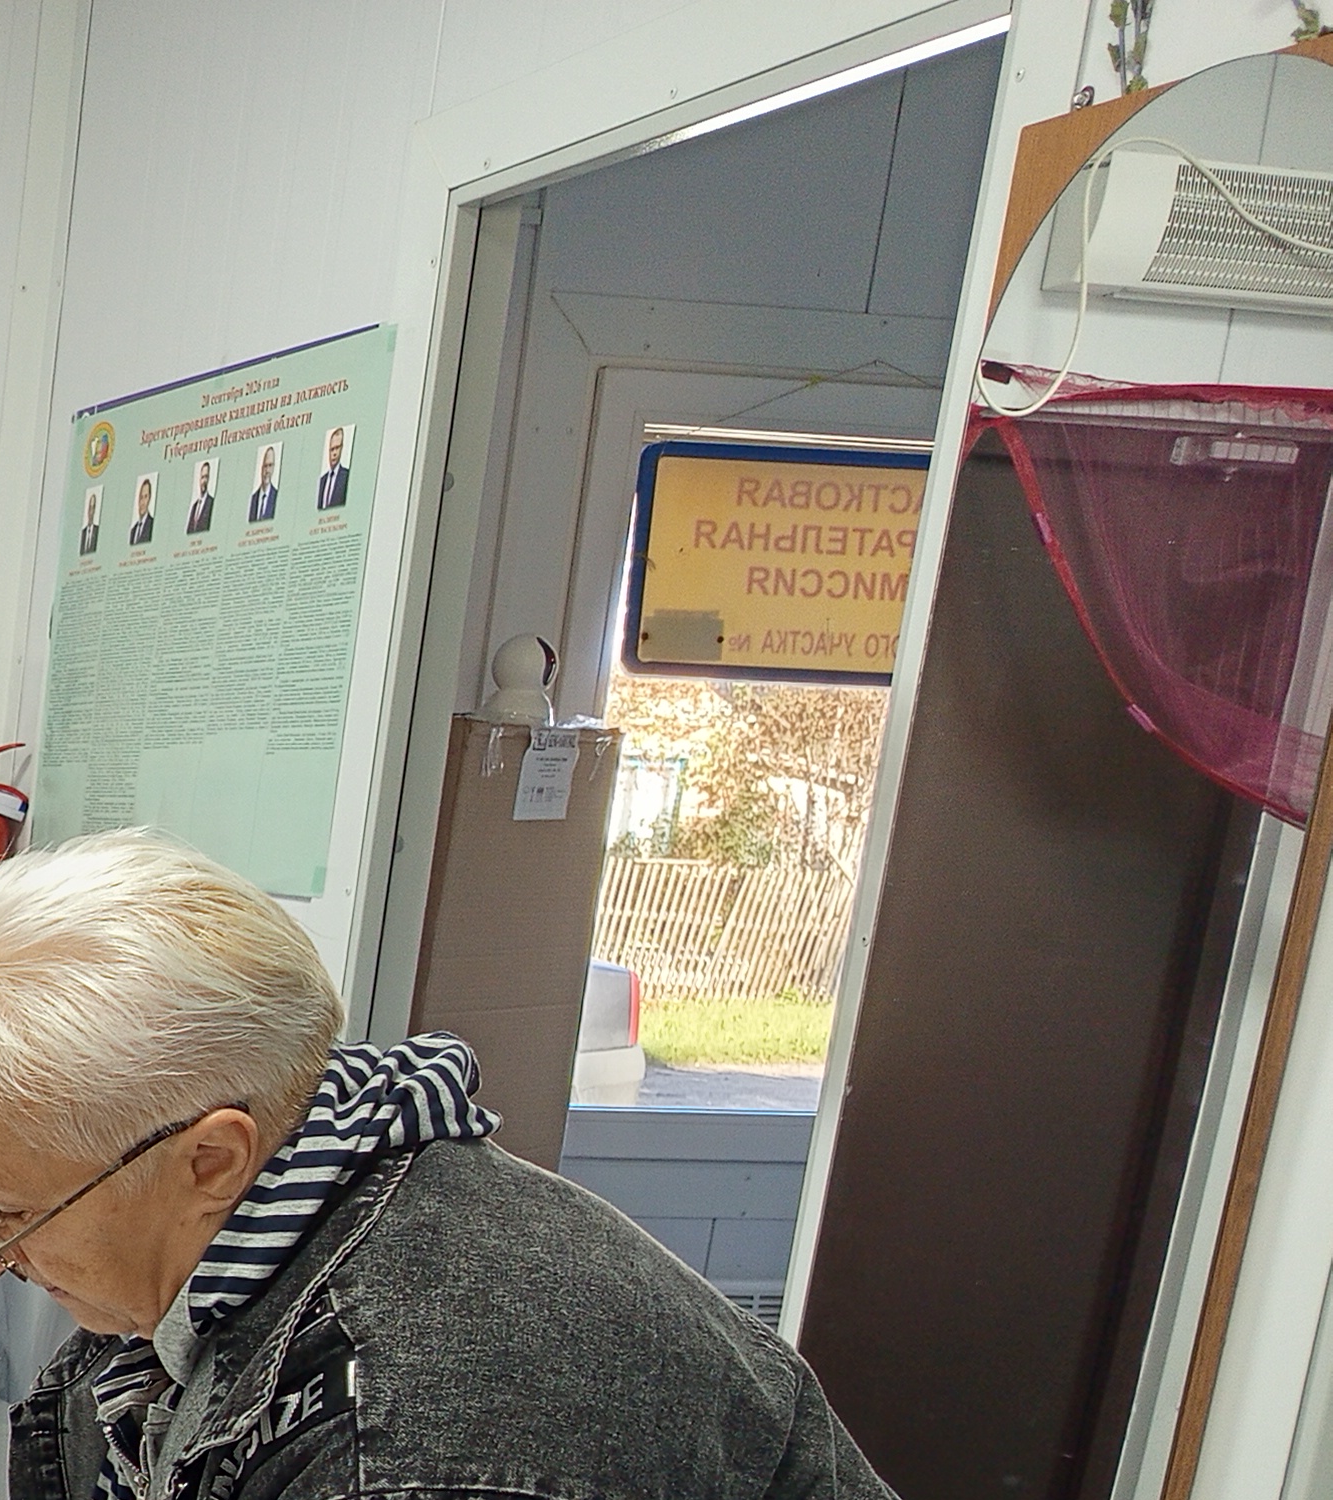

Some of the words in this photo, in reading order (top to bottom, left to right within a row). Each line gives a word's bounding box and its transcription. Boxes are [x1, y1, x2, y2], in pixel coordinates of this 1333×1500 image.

[140, 411, 227, 447] Зарегистрированные
[228, 396, 278, 422] кандидаты
[280, 395, 292, 408] на
[293, 377, 349, 406] должность
[210, 386, 243, 406] сентября
[262, 376, 280, 393] года
[164, 436, 219, 463] Губернатора
[220, 418, 272, 446] Пензенской
[273, 410, 313, 433] области
